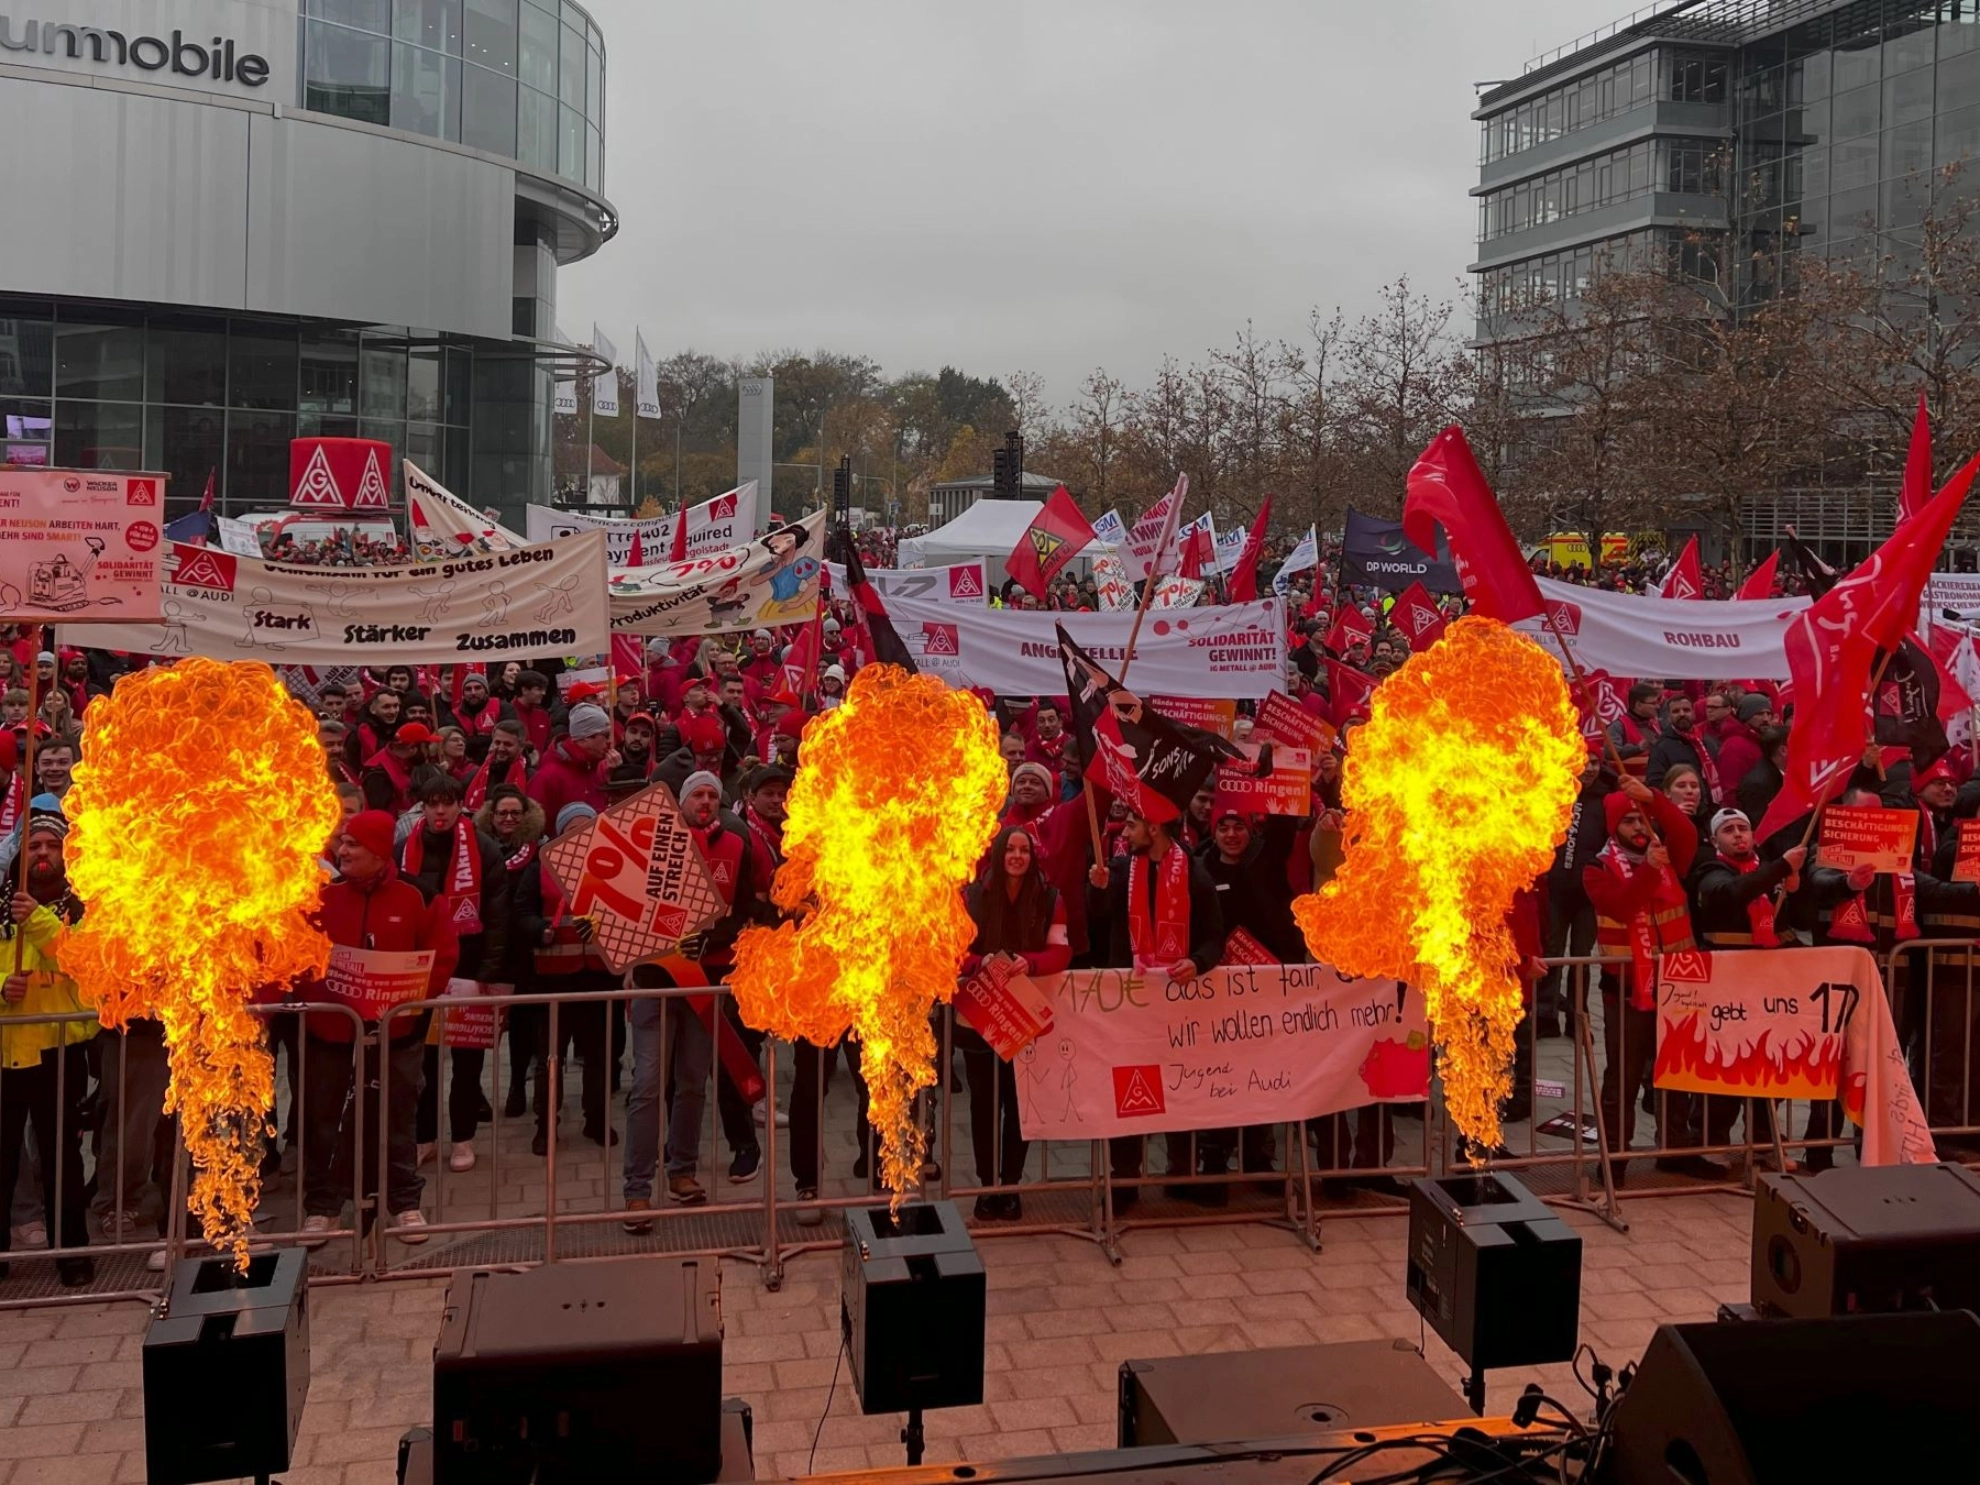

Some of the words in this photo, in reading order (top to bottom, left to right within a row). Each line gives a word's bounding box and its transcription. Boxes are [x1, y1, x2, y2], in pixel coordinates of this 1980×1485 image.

[9, 519, 47, 529] NEUSON
[49, 520, 94, 530] ARBEITEN
[95, 522, 121, 531] HART,
[641, 524, 671, 540] 402
[21, 532, 45, 541] SIND
[97, 561, 154, 570] SOLIDARITÄT
[441, 558, 494, 579] gutes
[499, 548, 554, 567] Leben
[1366, 561, 1380, 572] DP
[1380, 562, 1428, 574] WORLD
[113, 570, 154, 578] GEWINNT
[253, 610, 311, 630] Stark
[343, 622, 431, 645] Stärker
[456, 626, 577, 651] Zusammen
[1188, 629, 1276, 648] SOLIDARITÄT
[1663, 631, 1741, 648] ROHBAU
[1208, 647, 1277, 662] GEWINNT!
[1219, 664, 1247, 672] METALL
[1255, 781, 1307, 798] Ringen!
[651, 812, 675, 863] EINEN
[1823, 829, 1880, 843] SICHERUNG
[571, 816, 657, 924] 7%
[662, 830, 689, 902] STREICH
[645, 864, 660, 900] AUF
[1226, 963, 1259, 997] ist
[365, 986, 425, 1002] Ringen!
[1167, 1016, 1200, 1049] wir
[1212, 1009, 1273, 1044] wollen
[1282, 1000, 1339, 1035] endlich
[1351, 981, 1408, 1027] mehr!
[1709, 1002, 1748, 1032] gebt
[1763, 996, 1799, 1015] uns
[988, 1003, 1028, 1046] Ringen!
[1168, 1062, 1233, 1090] Jugend
[1209, 1082, 1238, 1098] bei
[1247, 1068, 1291, 1091] Audi
